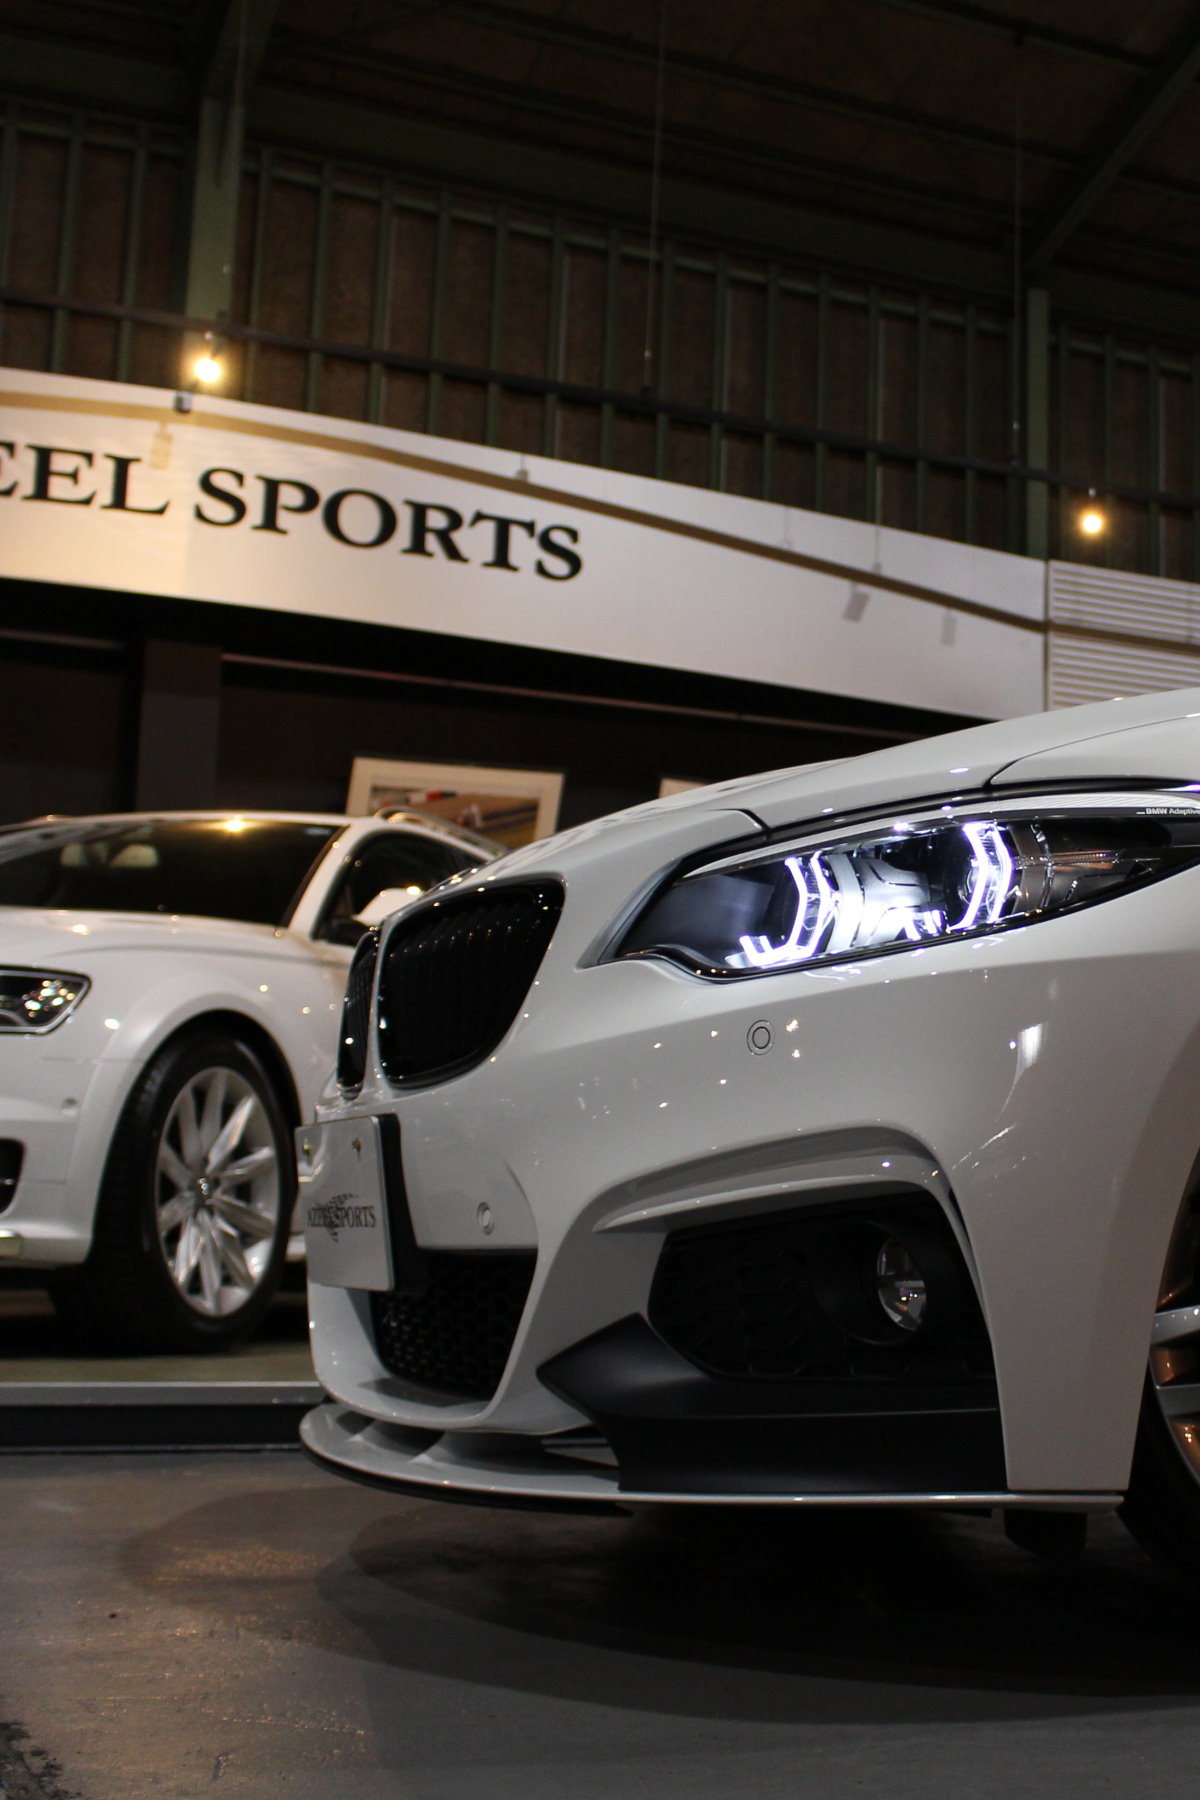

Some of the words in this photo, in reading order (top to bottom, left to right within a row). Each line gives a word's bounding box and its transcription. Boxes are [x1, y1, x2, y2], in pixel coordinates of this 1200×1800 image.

[0, 440, 169, 516] EL
[194, 466, 584, 582] SPORTS
[1145, 807, 1167, 815] BMW
